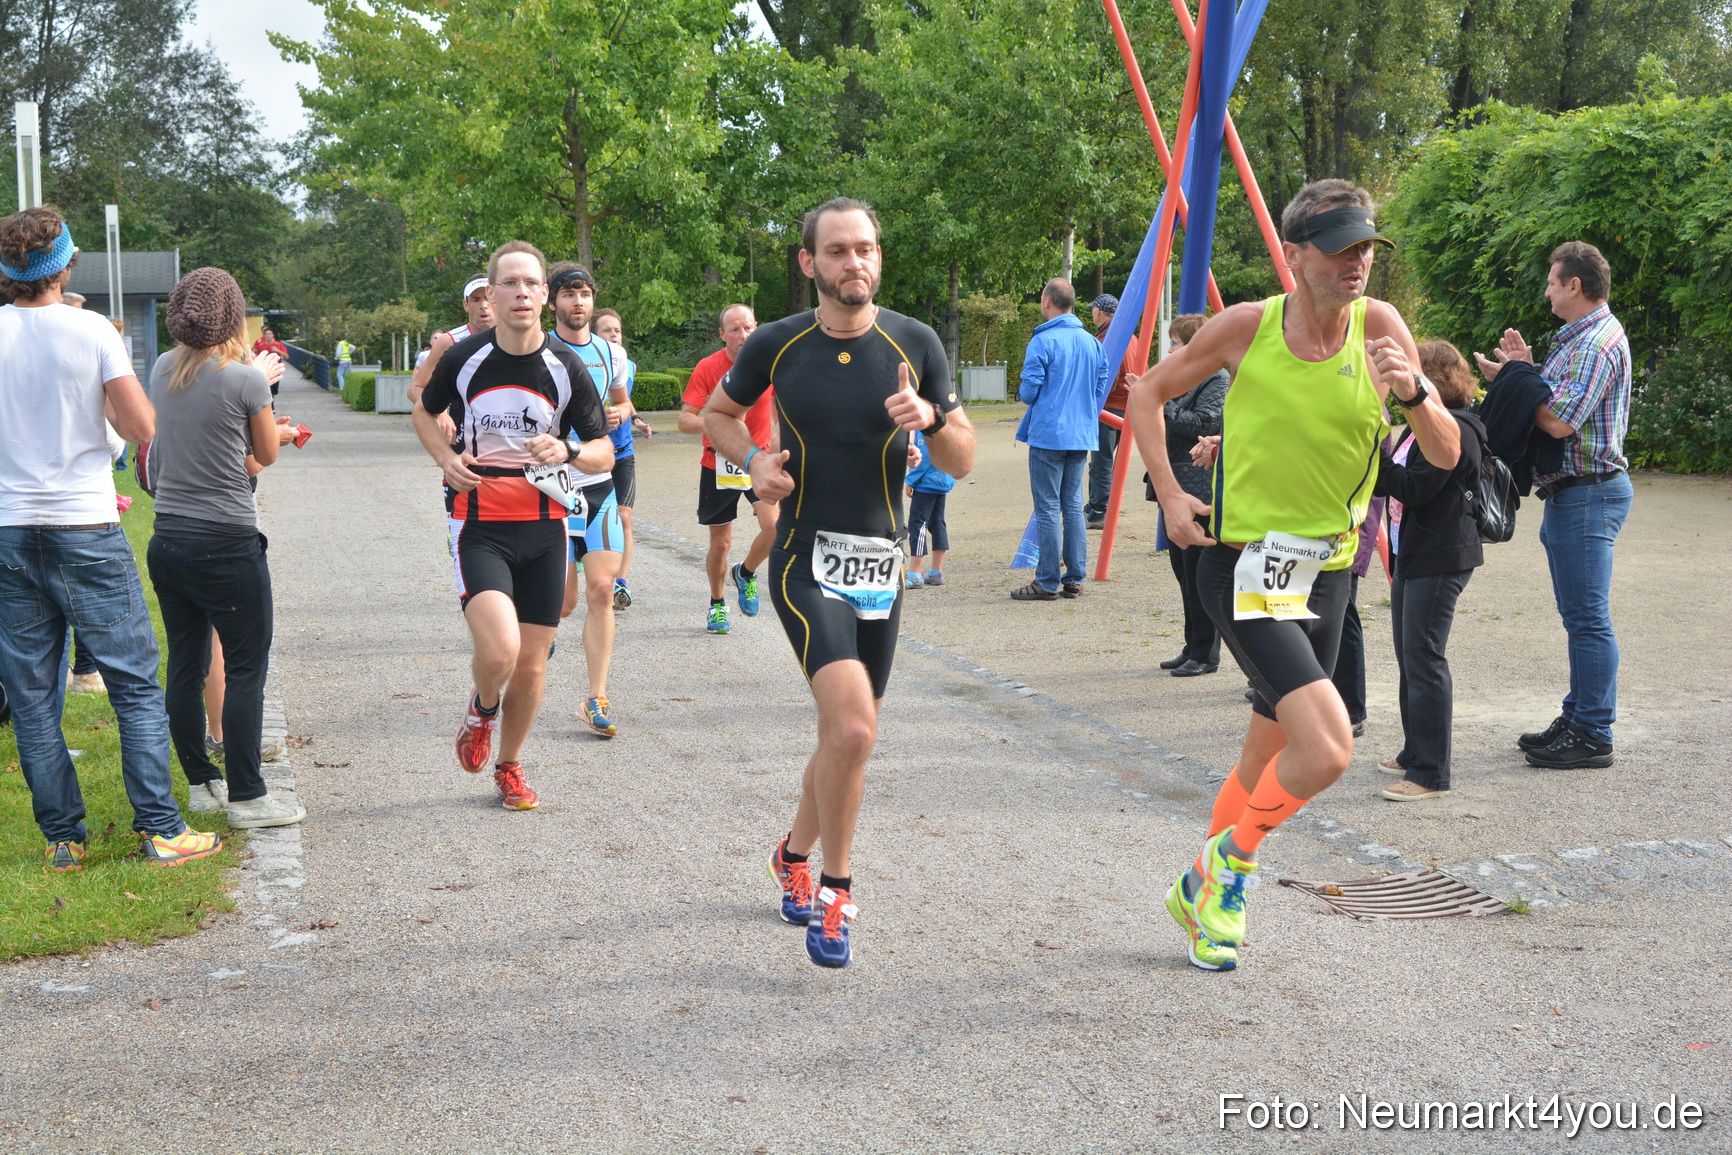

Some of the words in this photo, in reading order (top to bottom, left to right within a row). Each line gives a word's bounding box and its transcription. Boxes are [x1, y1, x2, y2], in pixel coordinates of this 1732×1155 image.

[1271, 541, 1317, 559] Neumarkt
[823, 554, 894, 587] 2059
[1263, 555, 1298, 590] 58
